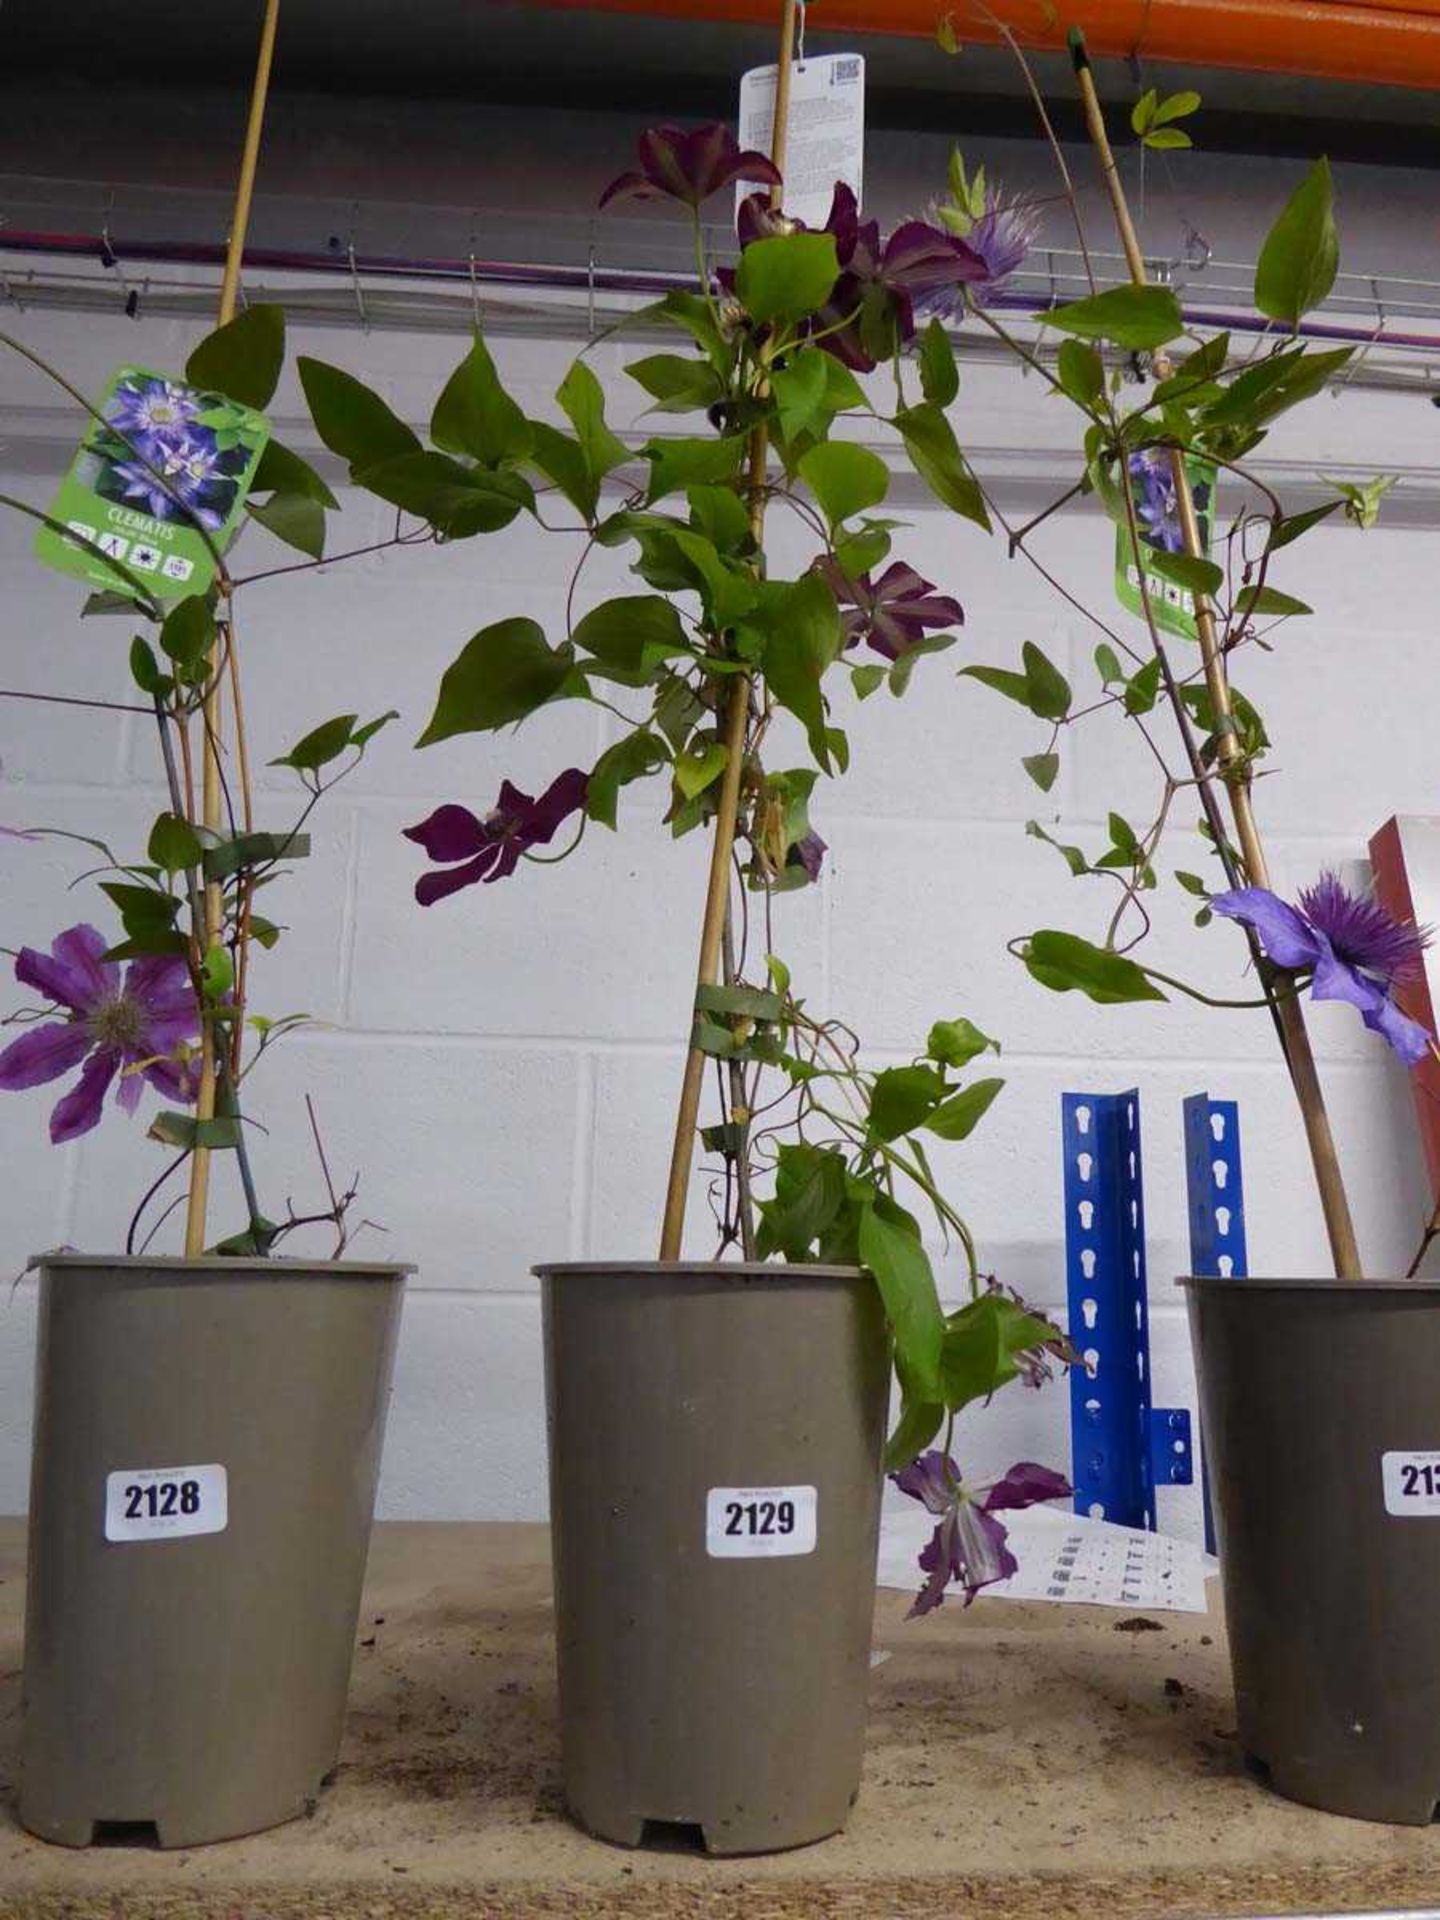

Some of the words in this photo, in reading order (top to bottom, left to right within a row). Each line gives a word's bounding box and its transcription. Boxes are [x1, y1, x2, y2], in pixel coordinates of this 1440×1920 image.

[107, 507, 176, 541] CLEMATIS
[125, 1480, 200, 1519] 2128
[725, 1501, 795, 1536] 2129
